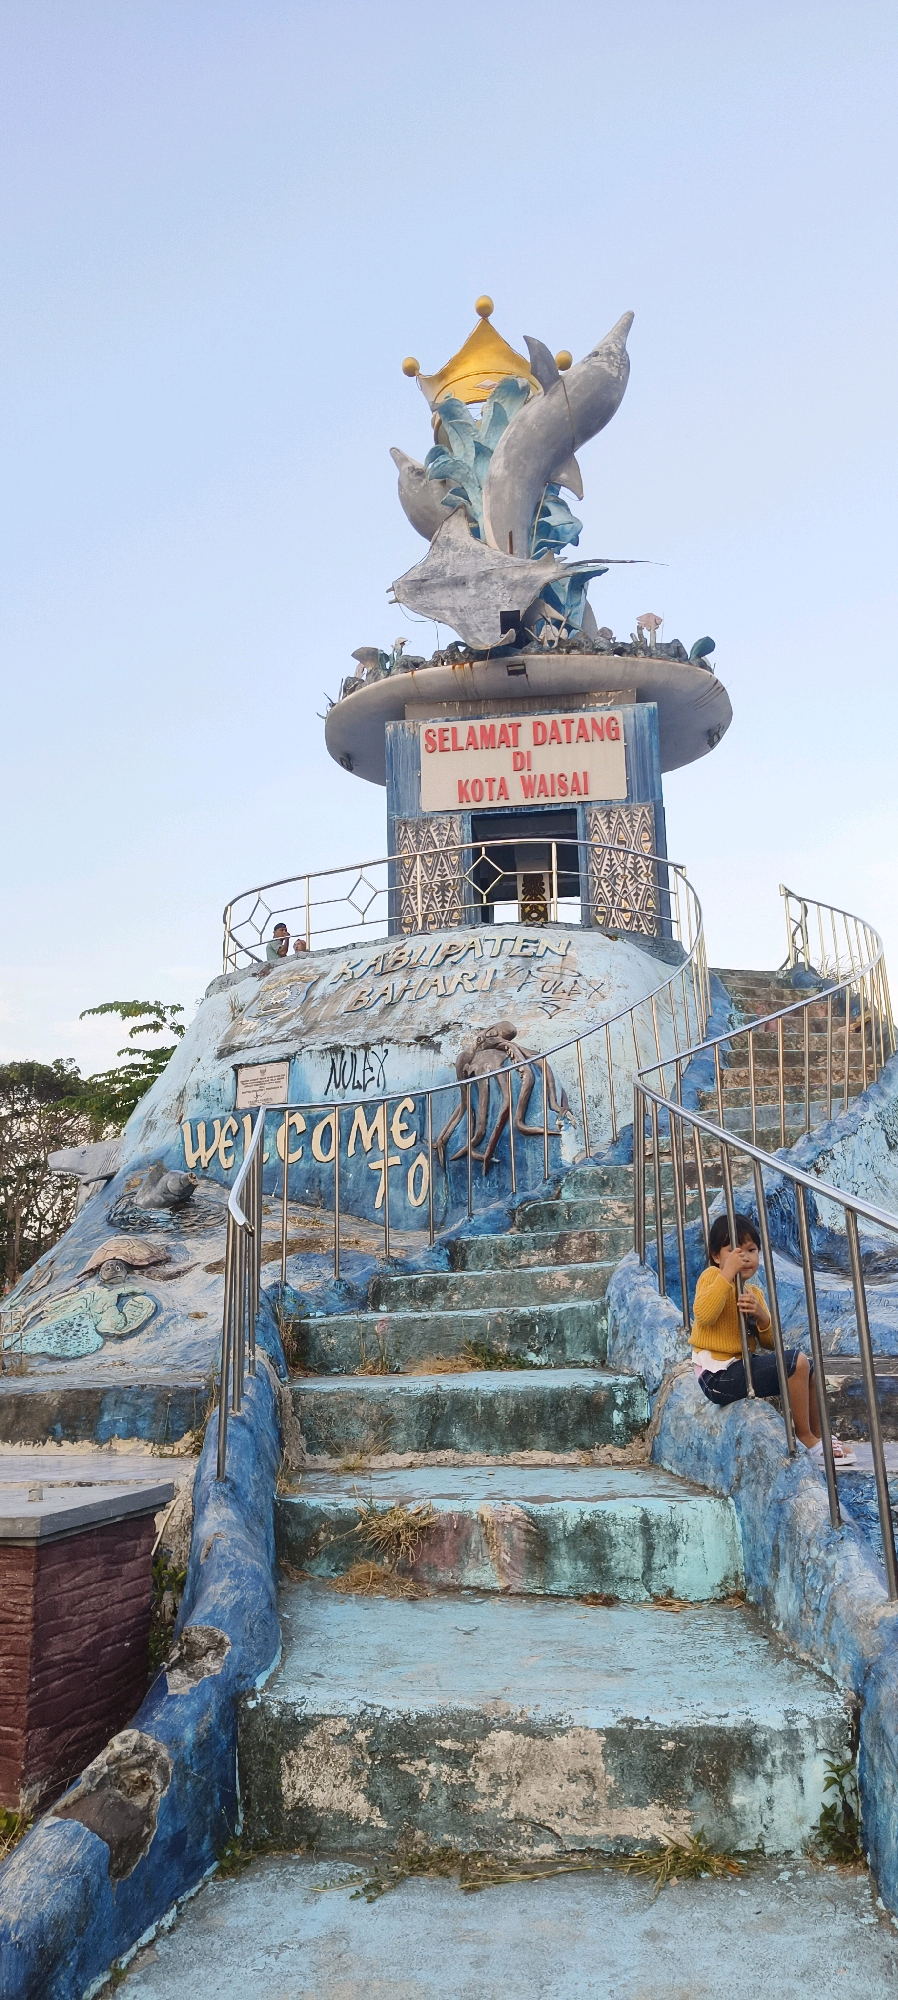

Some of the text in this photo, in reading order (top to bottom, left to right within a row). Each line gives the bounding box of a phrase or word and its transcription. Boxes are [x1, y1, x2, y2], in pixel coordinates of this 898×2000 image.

[424, 716, 620, 753] SELAMAT DATANG
[512, 750, 532, 772] DI
[457, 771, 590, 803] KOTA WAISAI
[329, 936, 572, 985] KABUPATEN
[343, 968, 497, 1013] BAHARI
[181, 1098, 416, 1170] WELCOME
[368, 1152, 429, 1209] TO
